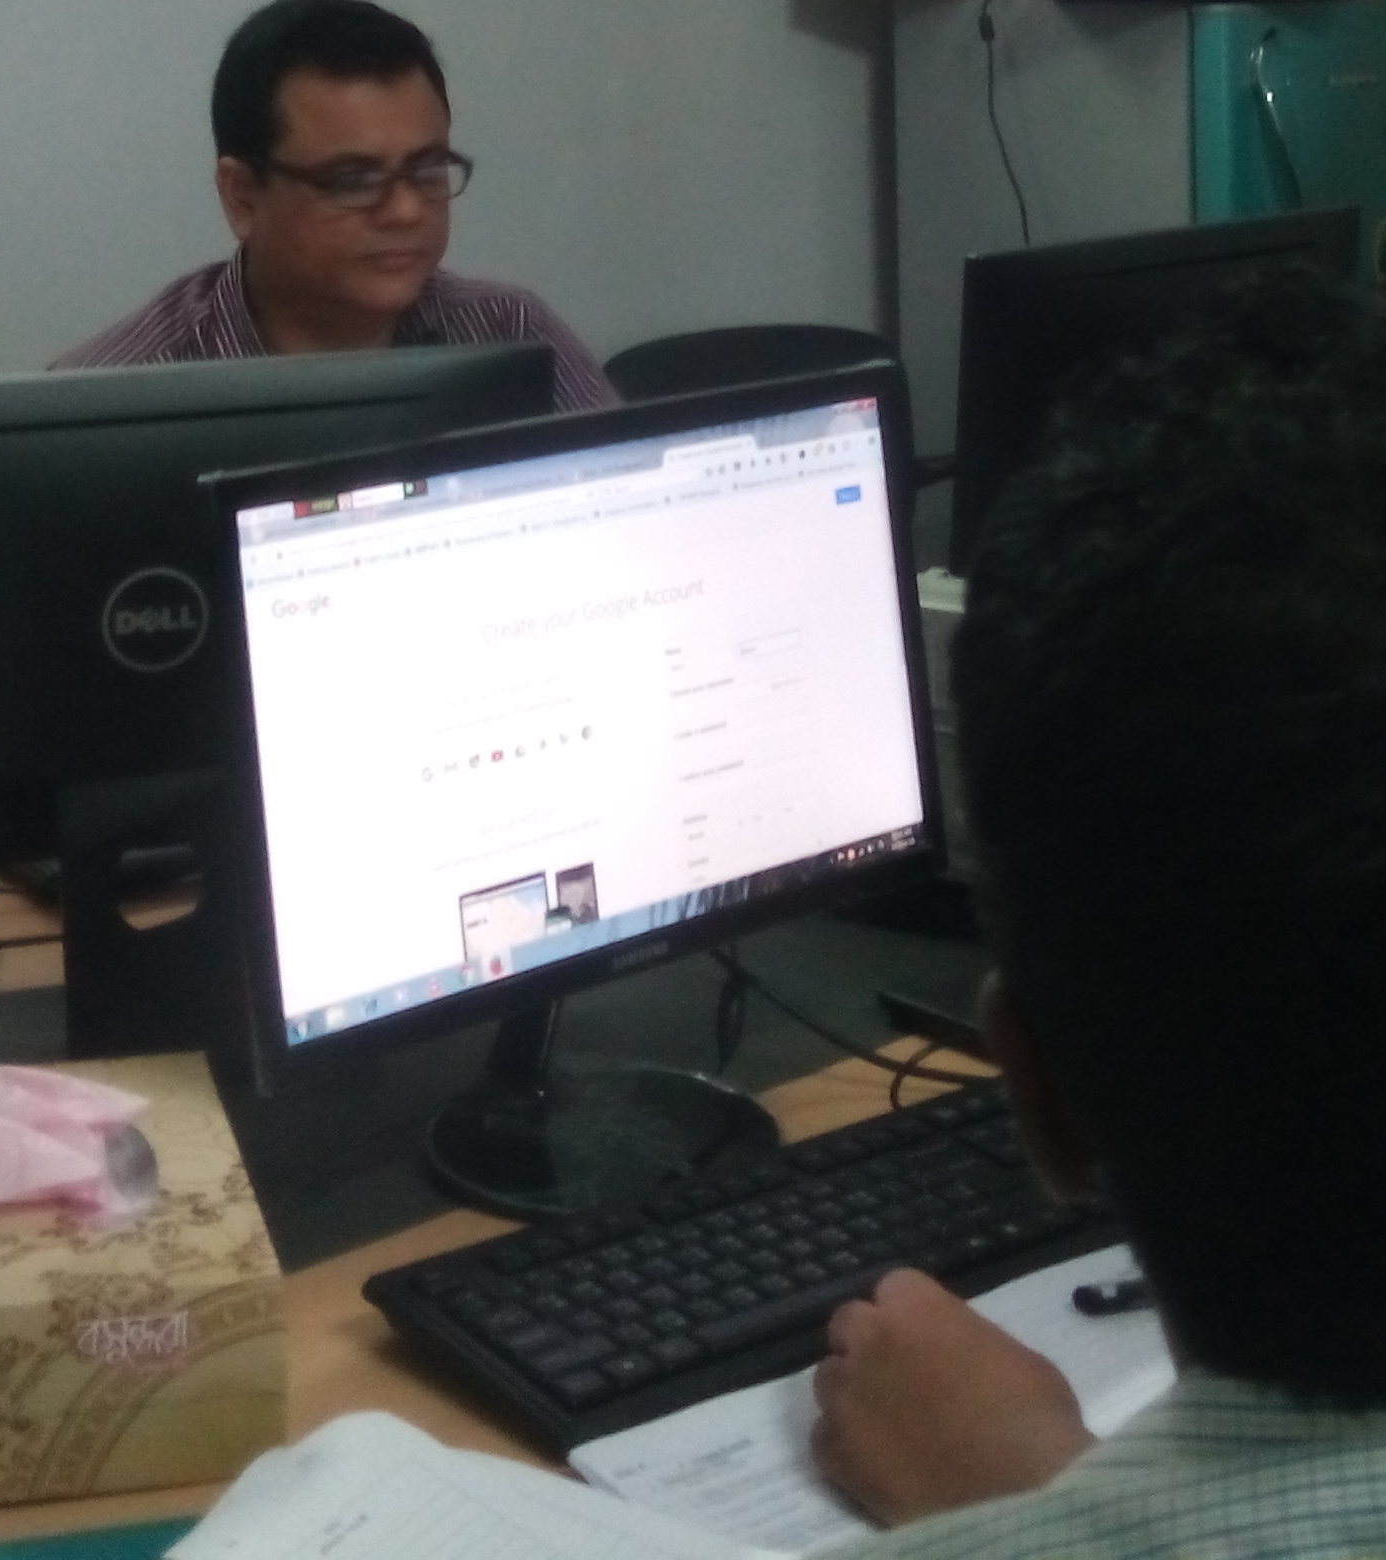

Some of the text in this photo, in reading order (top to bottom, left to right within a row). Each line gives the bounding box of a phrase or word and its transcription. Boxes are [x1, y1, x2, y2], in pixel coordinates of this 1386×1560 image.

[114, 604, 198, 636] DELL
[271, 592, 330, 619] Google
[481, 578, 705, 645] Create your Google Account
